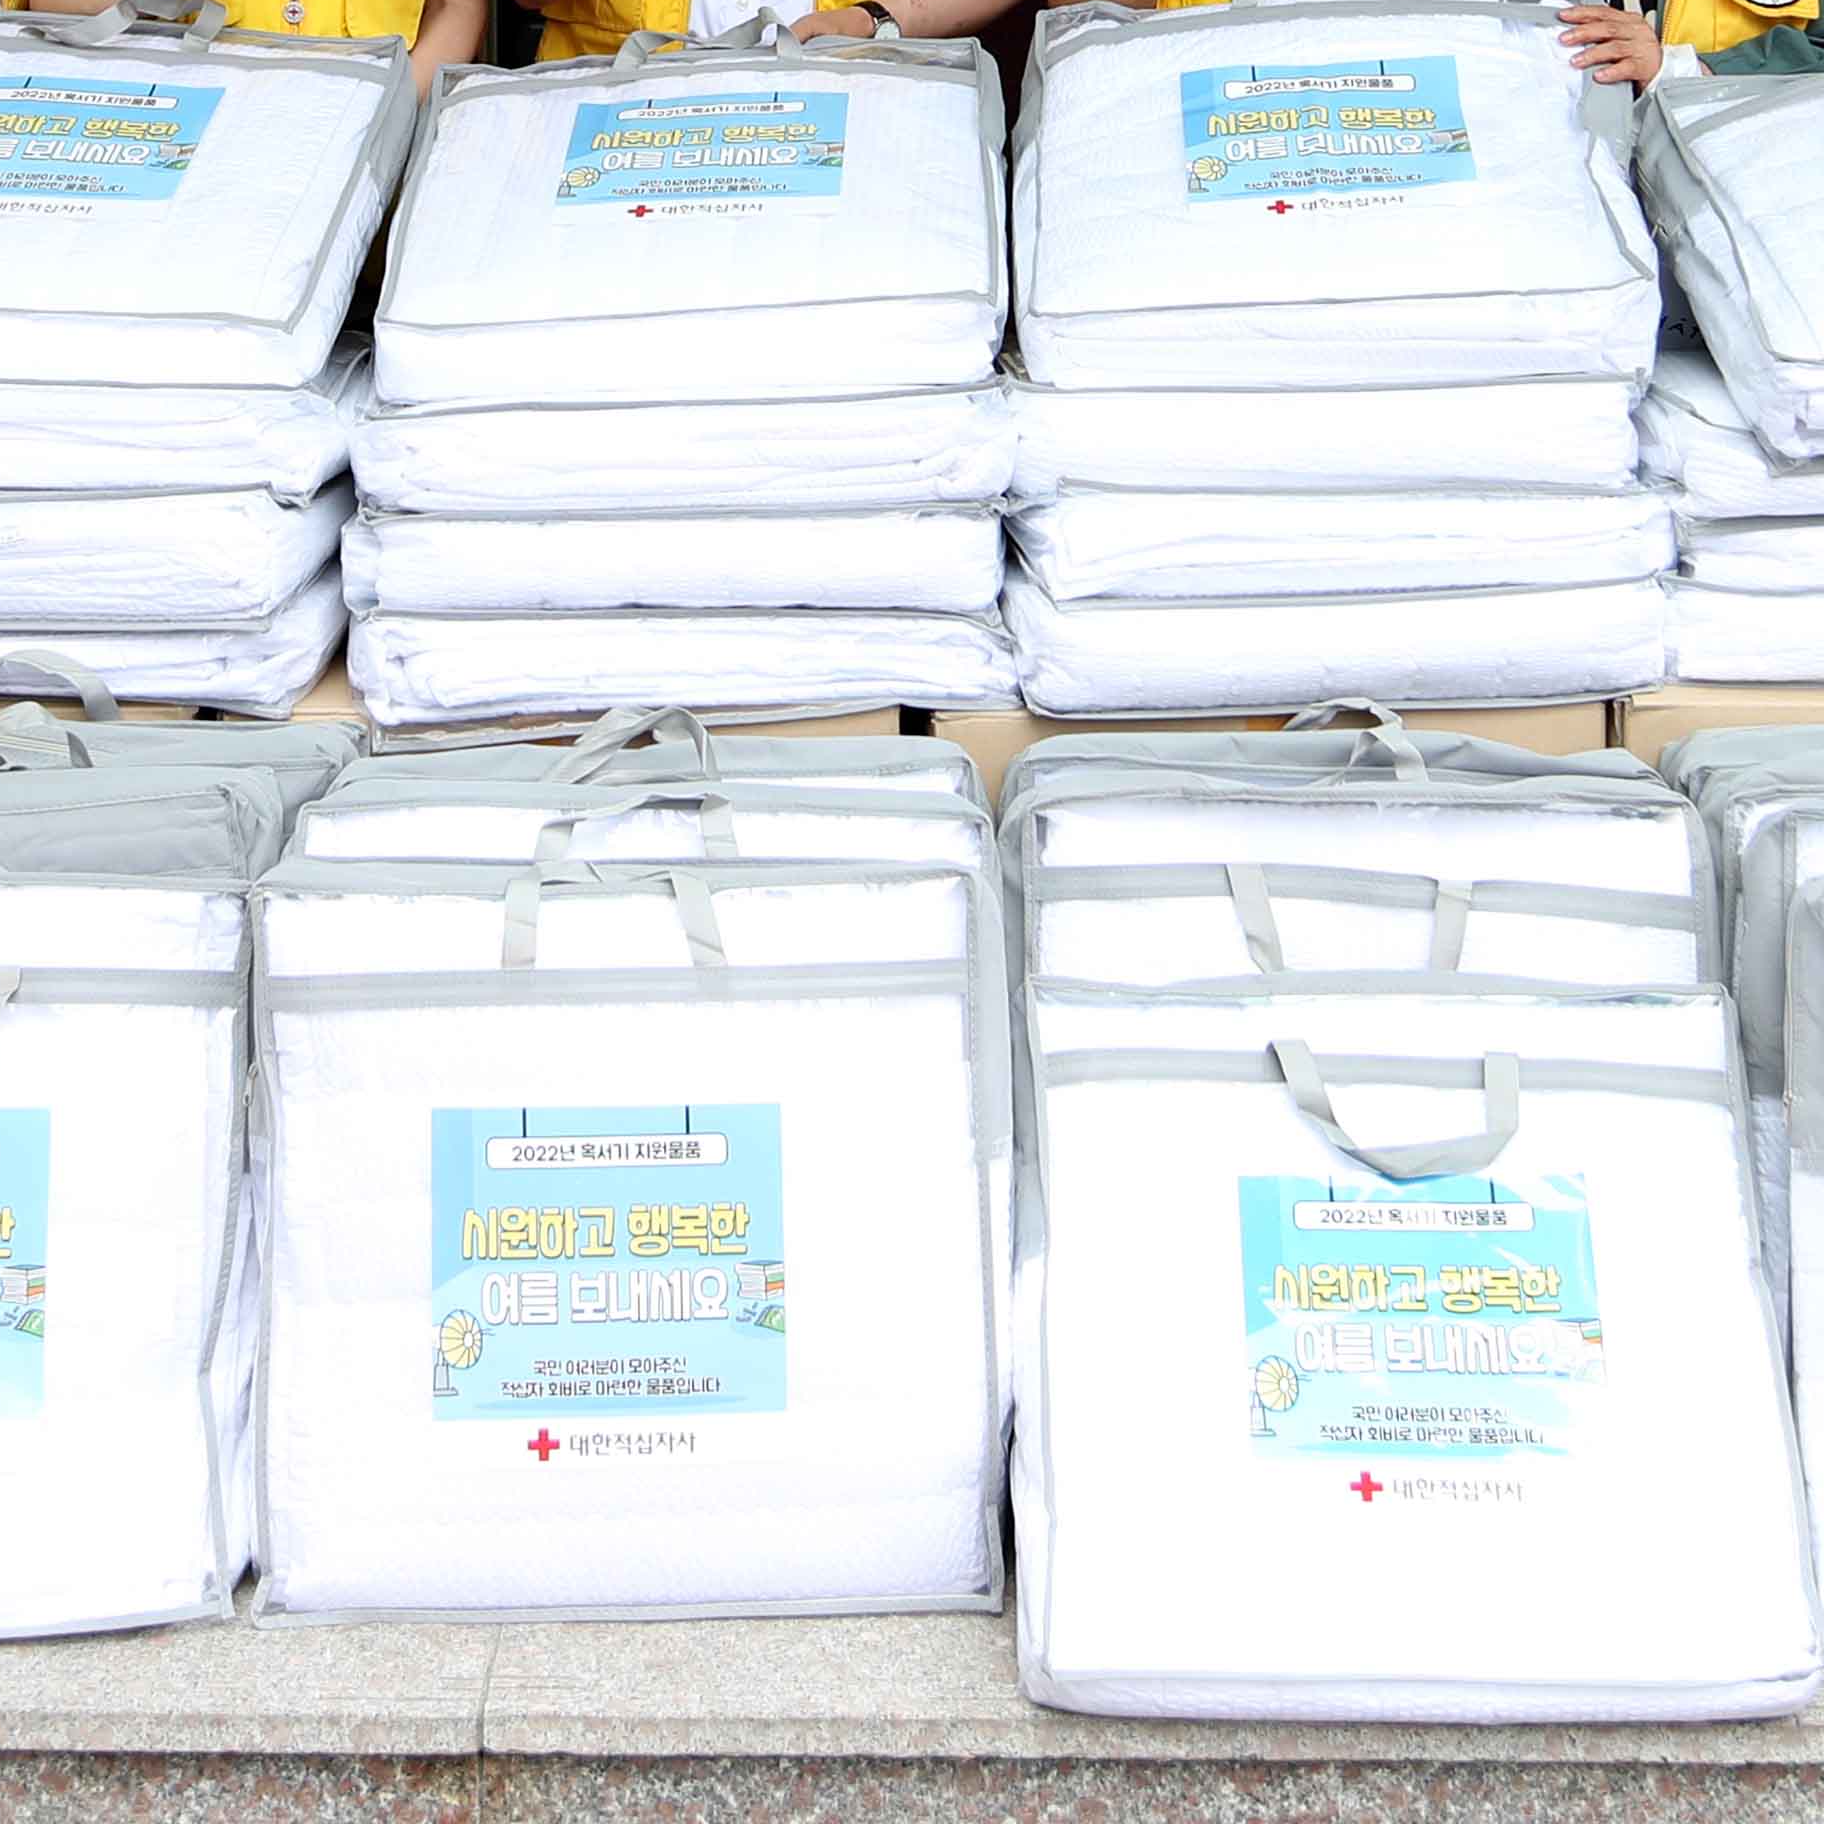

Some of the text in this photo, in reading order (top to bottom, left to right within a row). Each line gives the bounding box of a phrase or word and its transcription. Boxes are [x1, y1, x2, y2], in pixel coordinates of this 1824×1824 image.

[1207, 104, 1437, 137] 시원하고 행복한
[635, 1140, 702, 1161] 지원물품
[462, 1202, 751, 1260] 시원하고 행복한
[480, 1268, 729, 1326] 여름 보내세요
[1273, 1264, 1562, 1314] 시원하고 행복한
[1295, 1321, 1548, 1375] 여름 보내세요
[569, 1431, 697, 1457] 대한적십자사
